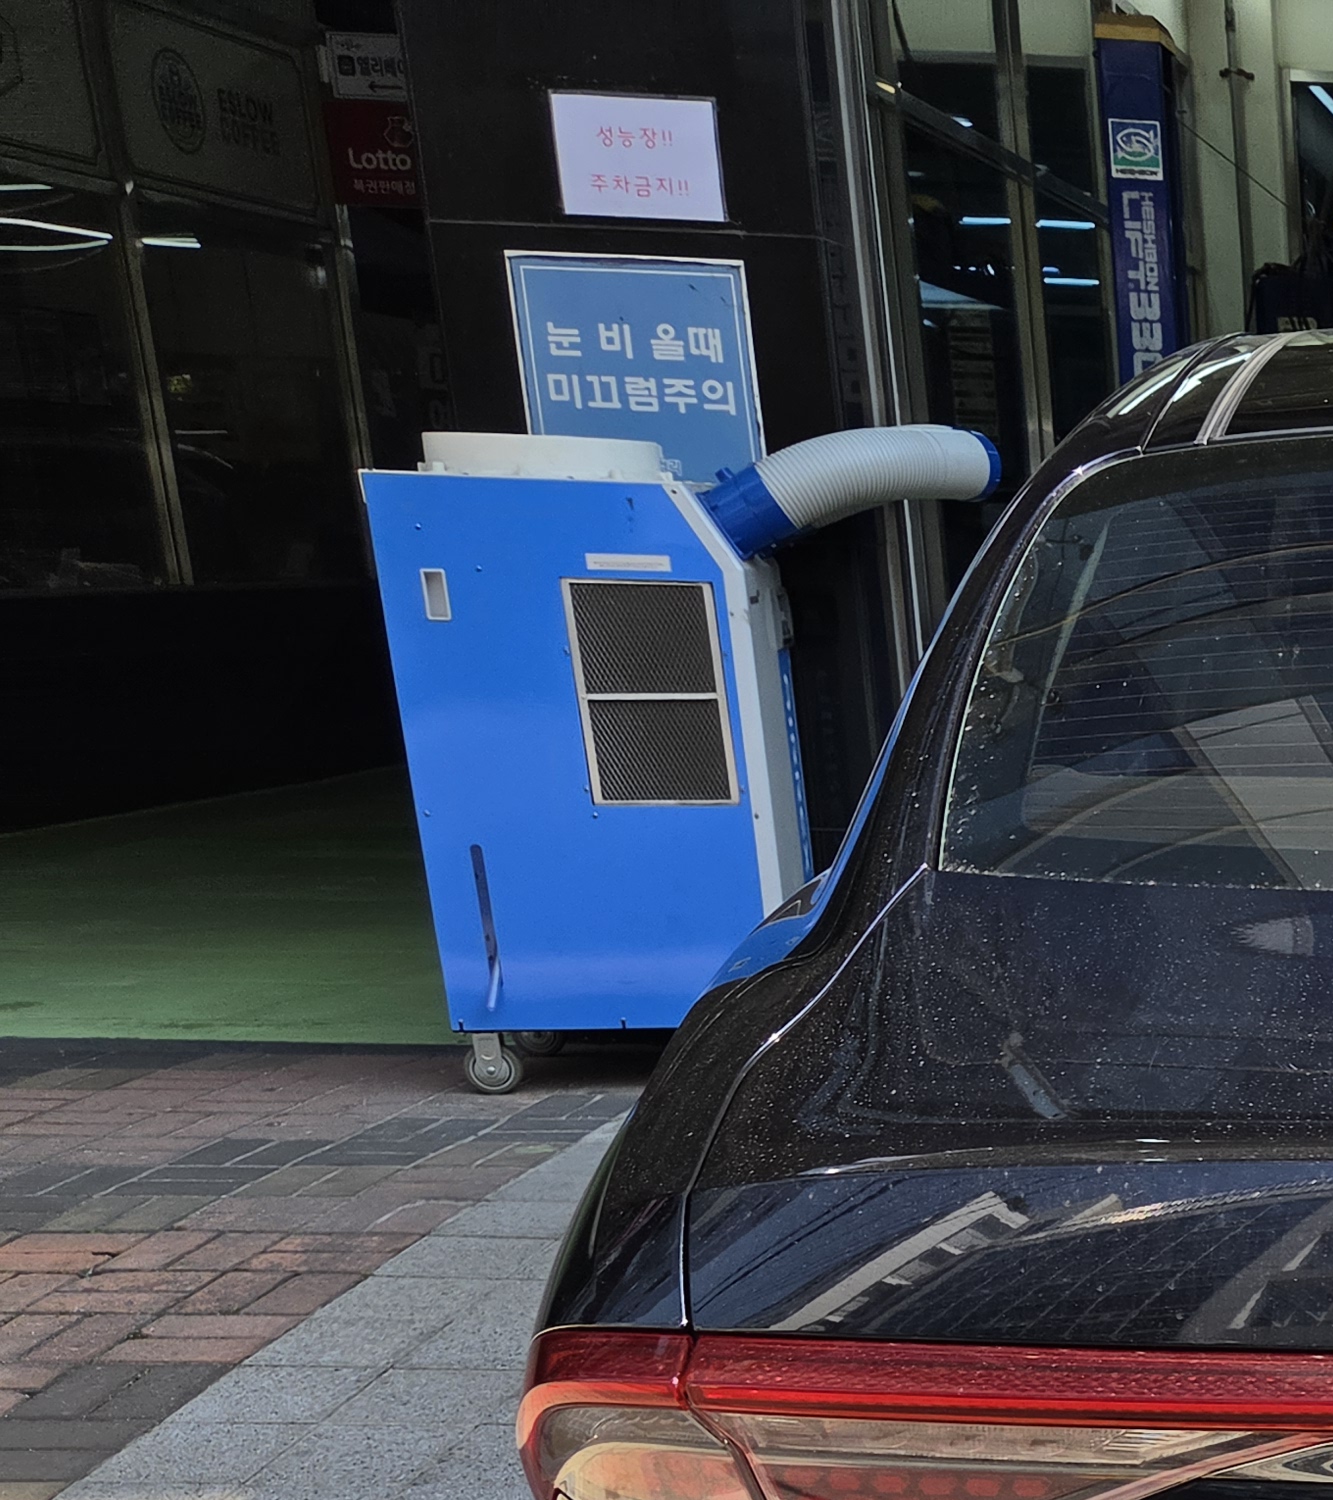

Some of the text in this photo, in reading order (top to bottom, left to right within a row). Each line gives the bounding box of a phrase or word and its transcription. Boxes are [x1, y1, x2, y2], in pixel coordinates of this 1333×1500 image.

[595, 125, 674, 150] 성능장!!
[348, 147, 412, 171] Lotto
[353, 178, 416, 196] 복권판매점
[590, 173, 691, 199] 주차금지!!
[1140, 190, 1160, 292] HESHBON
[546, 321, 725, 364] 눈 비 올때
[546, 372, 737, 417] 미끄럼주의
